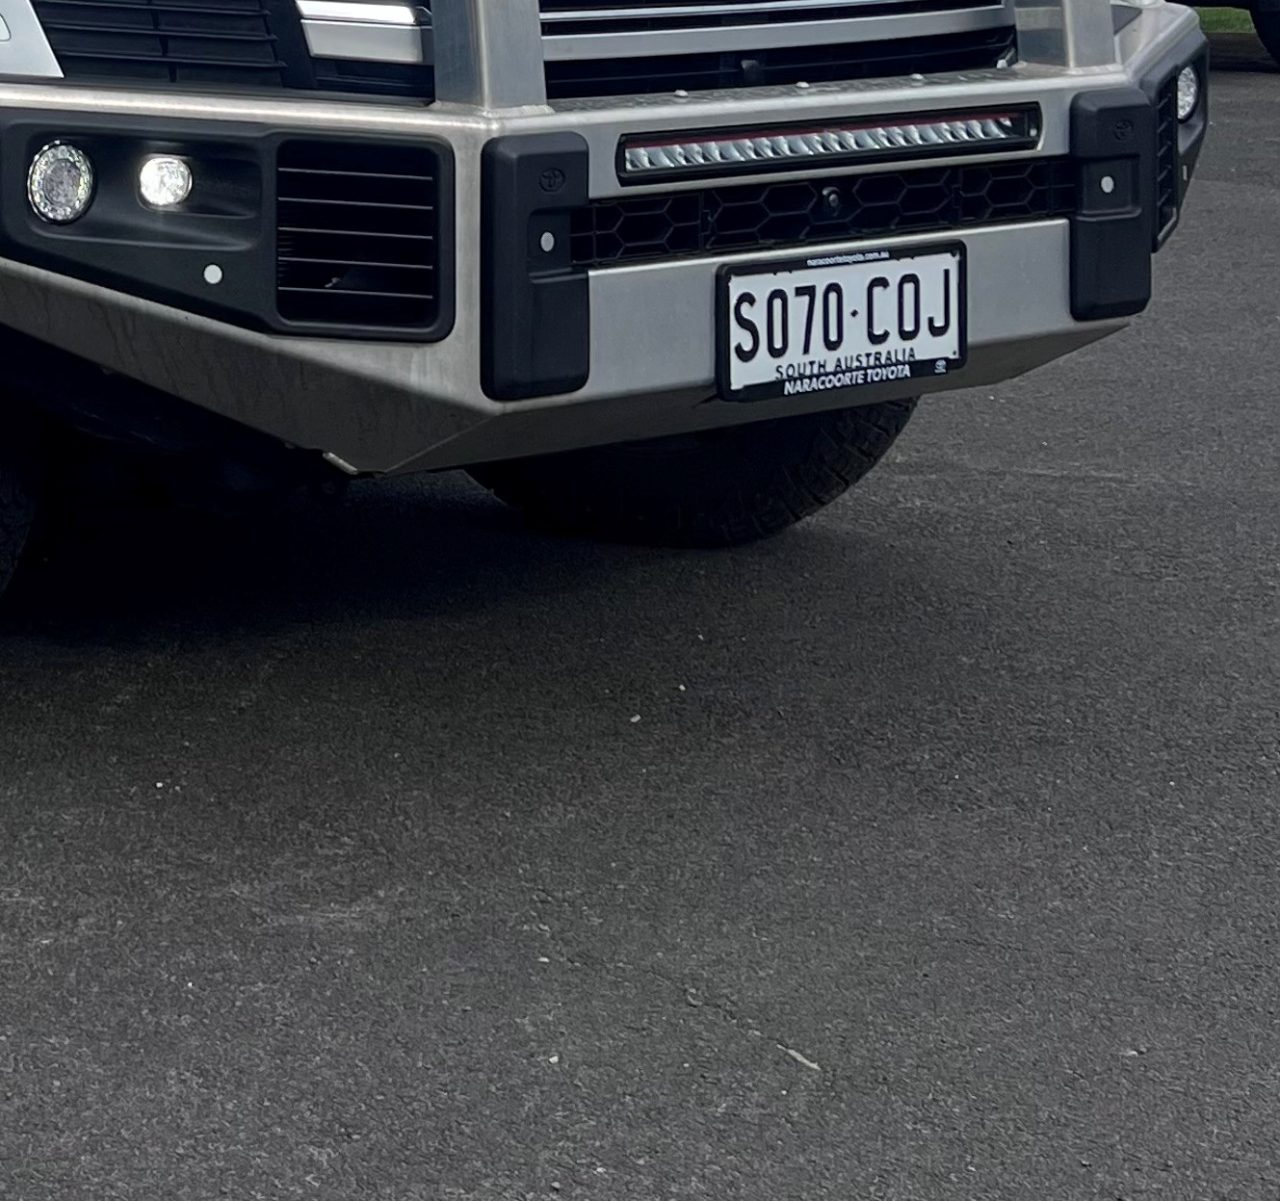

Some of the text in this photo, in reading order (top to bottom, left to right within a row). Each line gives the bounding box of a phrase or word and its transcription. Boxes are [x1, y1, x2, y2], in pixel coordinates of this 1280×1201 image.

[774, 347, 917, 381] SOUTH AUSTRALIA
[783, 364, 912, 395] NARACOORTE TOYOTA
